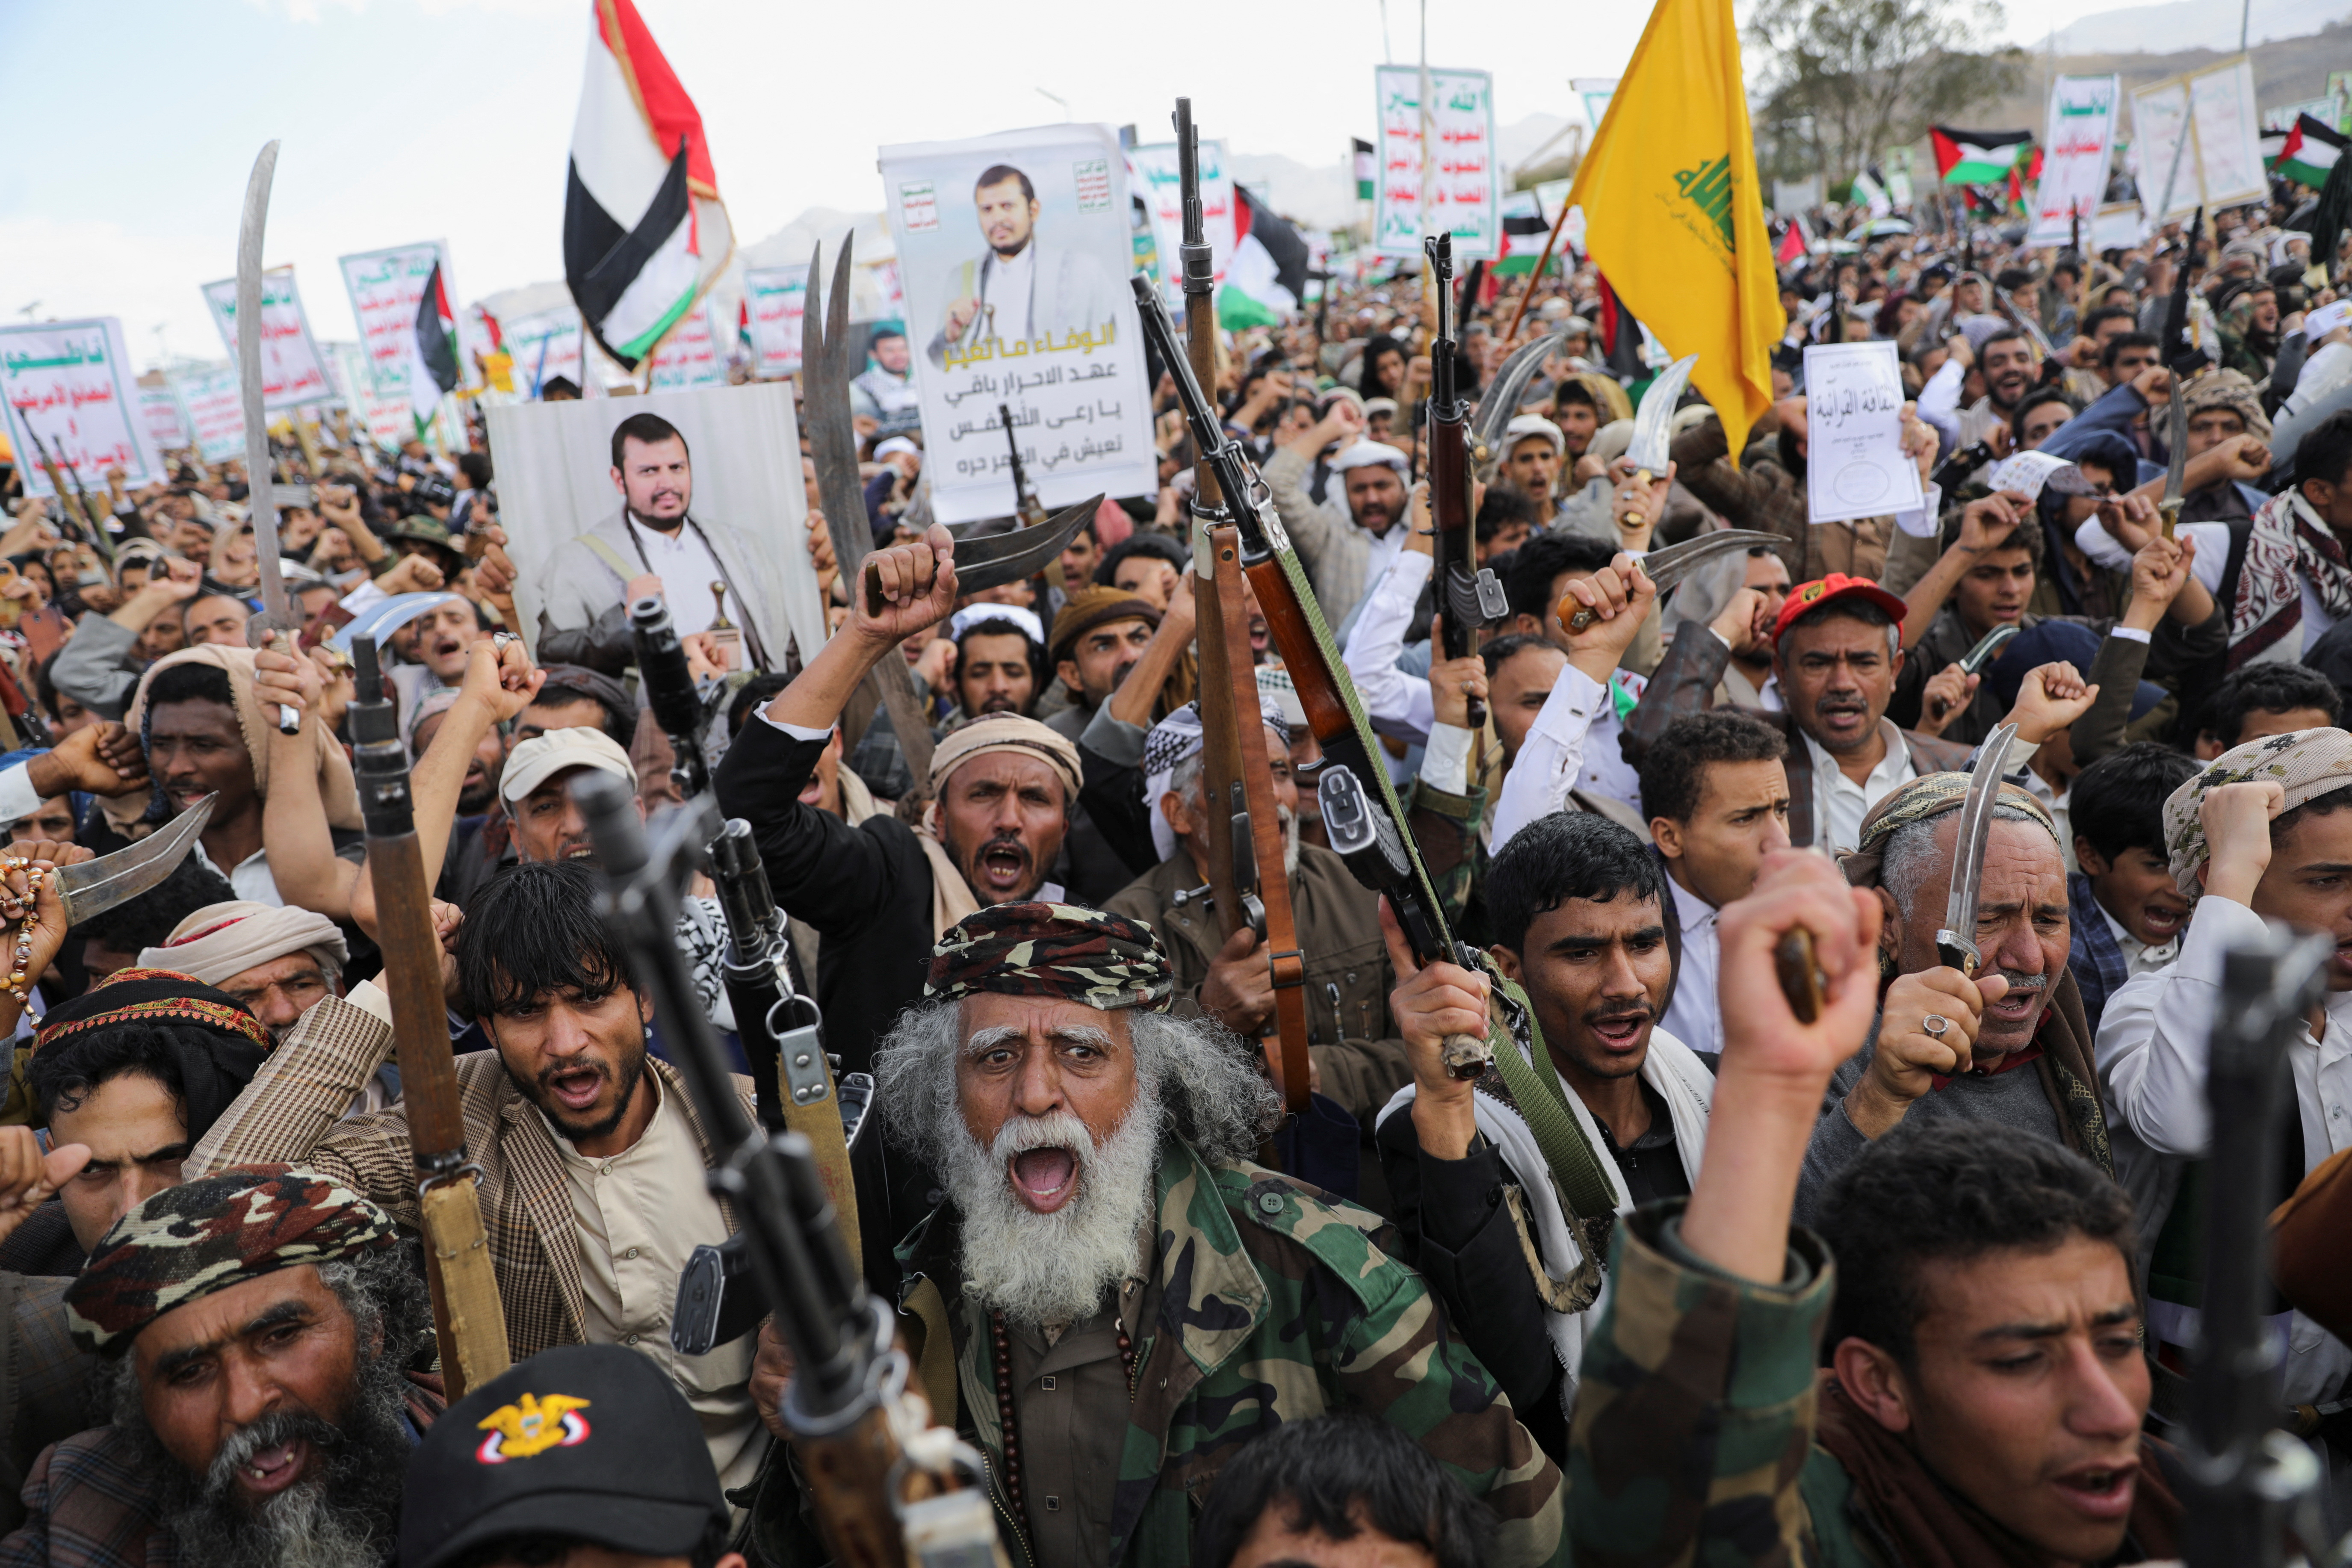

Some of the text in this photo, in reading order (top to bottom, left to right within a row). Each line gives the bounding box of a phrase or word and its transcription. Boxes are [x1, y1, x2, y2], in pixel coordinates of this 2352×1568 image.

[943, 323, 1115, 372] الوفاء ما تغير
[944, 363, 1117, 408] عهد الاحرار باقي
[1046, 405, 1094, 429] رعى
[1098, 398, 1121, 419] يا
[956, 457, 987, 477] حره
[1041, 441, 1070, 470] في
